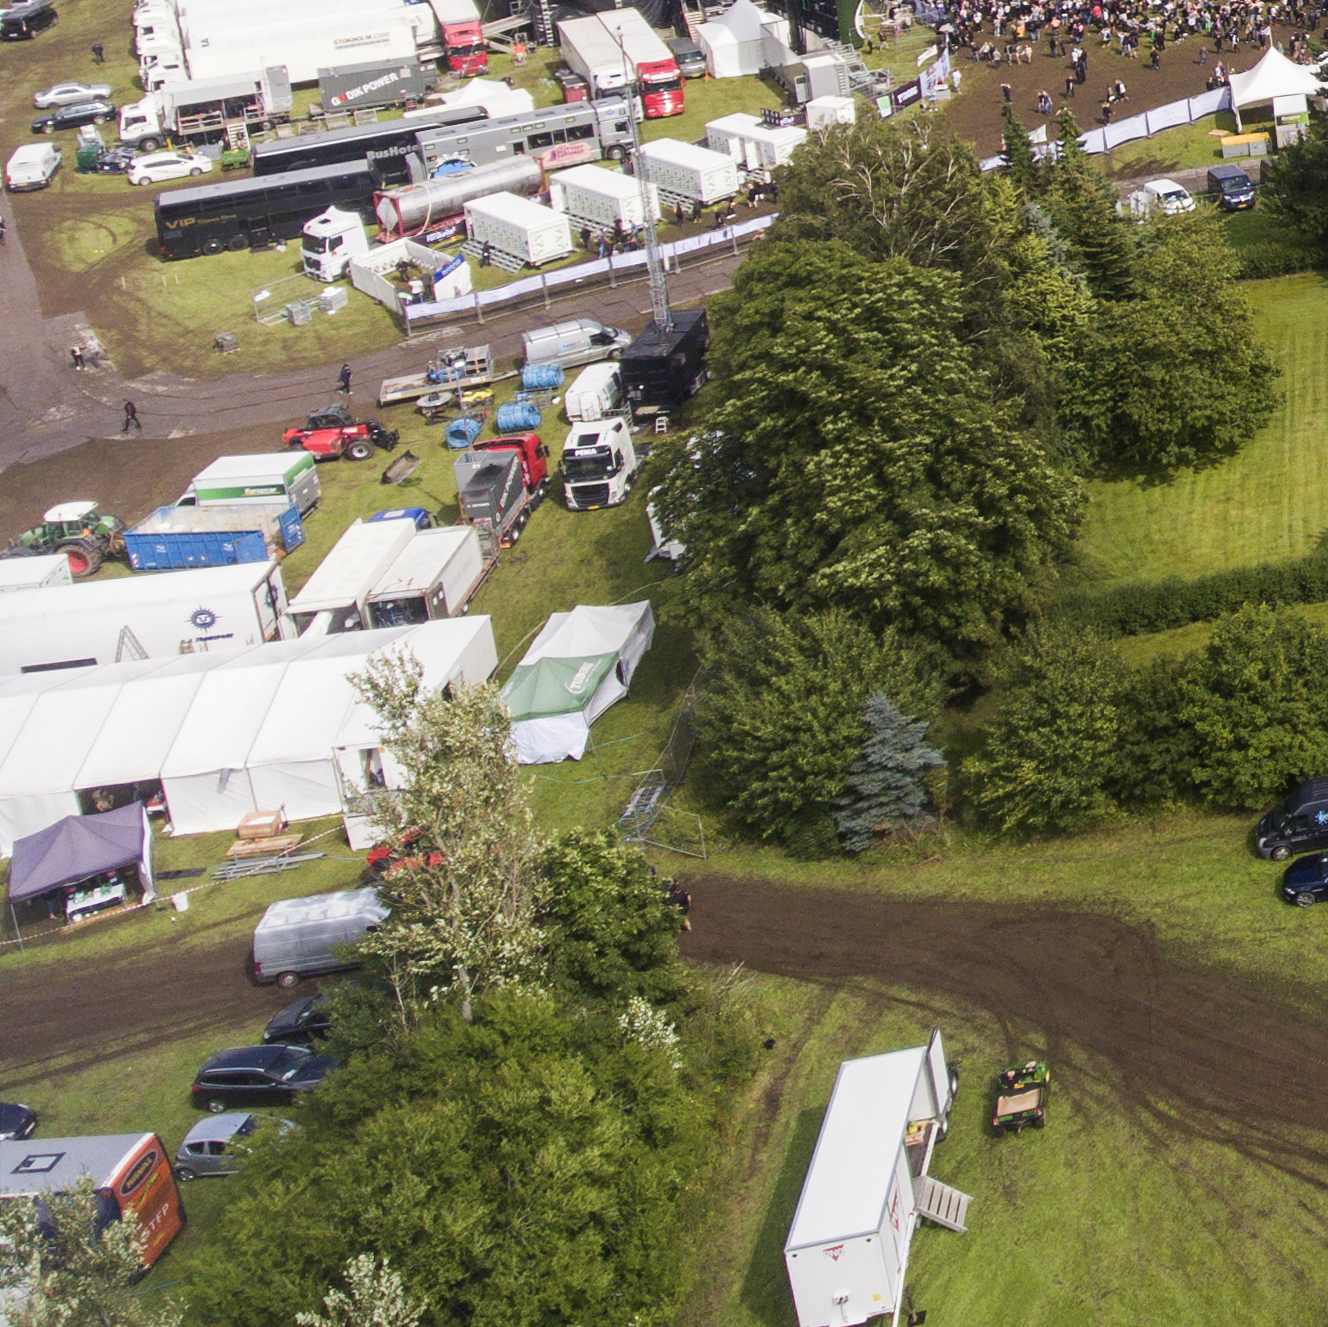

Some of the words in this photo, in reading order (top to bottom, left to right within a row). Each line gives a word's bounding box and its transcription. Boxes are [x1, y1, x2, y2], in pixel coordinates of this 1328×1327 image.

[363, 72, 399, 95] POWER
[366, 143, 419, 160] BusHote
[165, 217, 196, 229] VIP
[574, 448, 597, 457] PEMA
